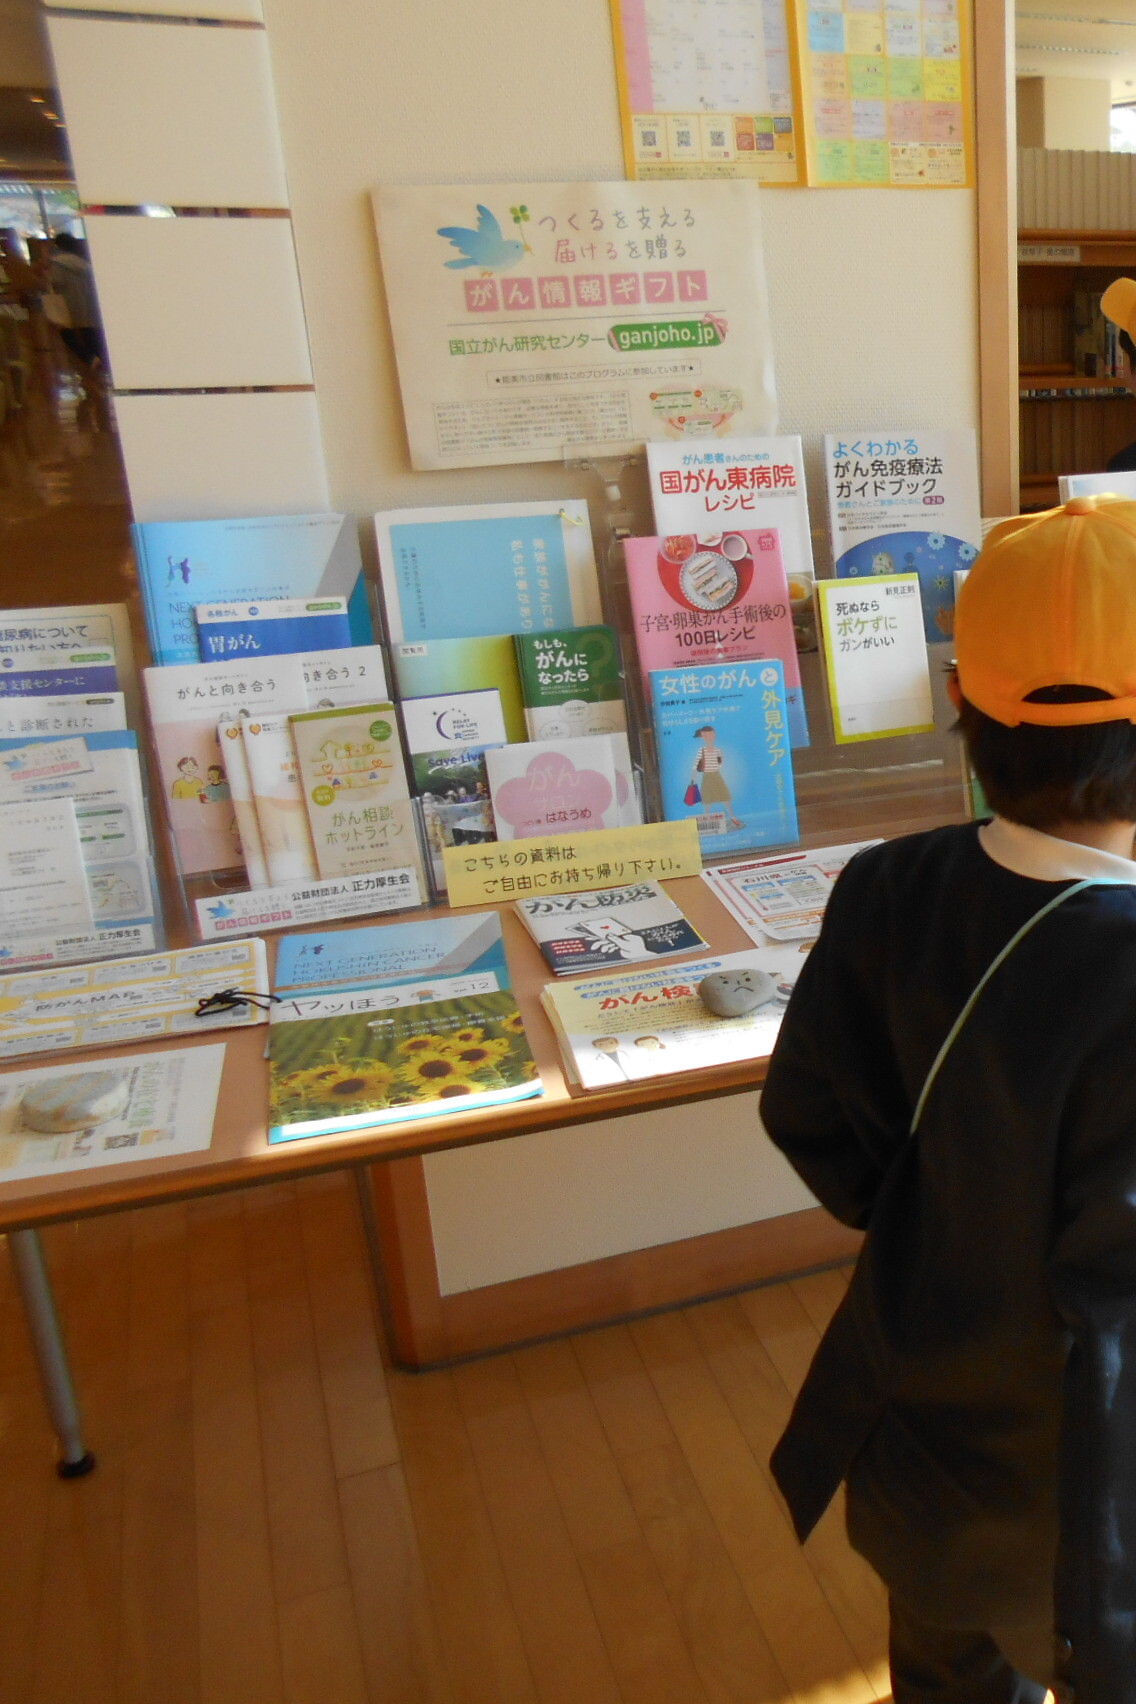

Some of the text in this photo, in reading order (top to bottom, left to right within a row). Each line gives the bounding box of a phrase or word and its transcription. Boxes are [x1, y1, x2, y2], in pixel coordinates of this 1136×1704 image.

[538, 206, 697, 231] つくるを支える
[554, 238, 688, 264] 届けるを贈る
[469, 273, 704, 308] がん情報ギフト
[449, 331, 606, 356] 国立がん研究センター
[619, 324, 714, 351] ganjoho.jp
[683, 453, 769, 466] がん患者さんのための
[833, 439, 919, 459] よくわかる
[834, 457, 943, 479] がん免疫療法
[660, 464, 797, 494] 国がん東病院
[836, 478, 937, 499] ガイドブック
[705, 493, 756, 512] レシピ
[640, 603, 787, 633] 子宮・卵巣がん手術後の
[835, 600, 880, 617] 死ぬなら
[0, 625, 89, 641] 尿病について
[675, 625, 756, 647] 100日レシピ
[837, 616, 898, 637] ボケずに
[209, 634, 261, 654] 胃がん
[533, 638, 567, 649] もしも、
[840, 636, 895, 652] ガンがいい
[536, 651, 588, 669] がんに
[359, 666, 367, 677] 2
[538, 668, 590, 684] なったら
[177, 679, 276, 700] がんと向き合う
[0, 717, 93, 733] と診断された
[761, 689, 786, 767] 外見ケア
[428, 756, 457, 768] Save
[332, 805, 394, 828] がん相談
[546, 808, 592, 824] はなうめ
[326, 822, 404, 845] ホットライン
[464, 846, 577, 872] こちらの資料は
[483, 857, 682, 894] ご自由にお持ち帰り下さい。
[291, 873, 411, 902] 公益財団法人 正力厚生会
[281, 995, 401, 1016] ヤッほう
